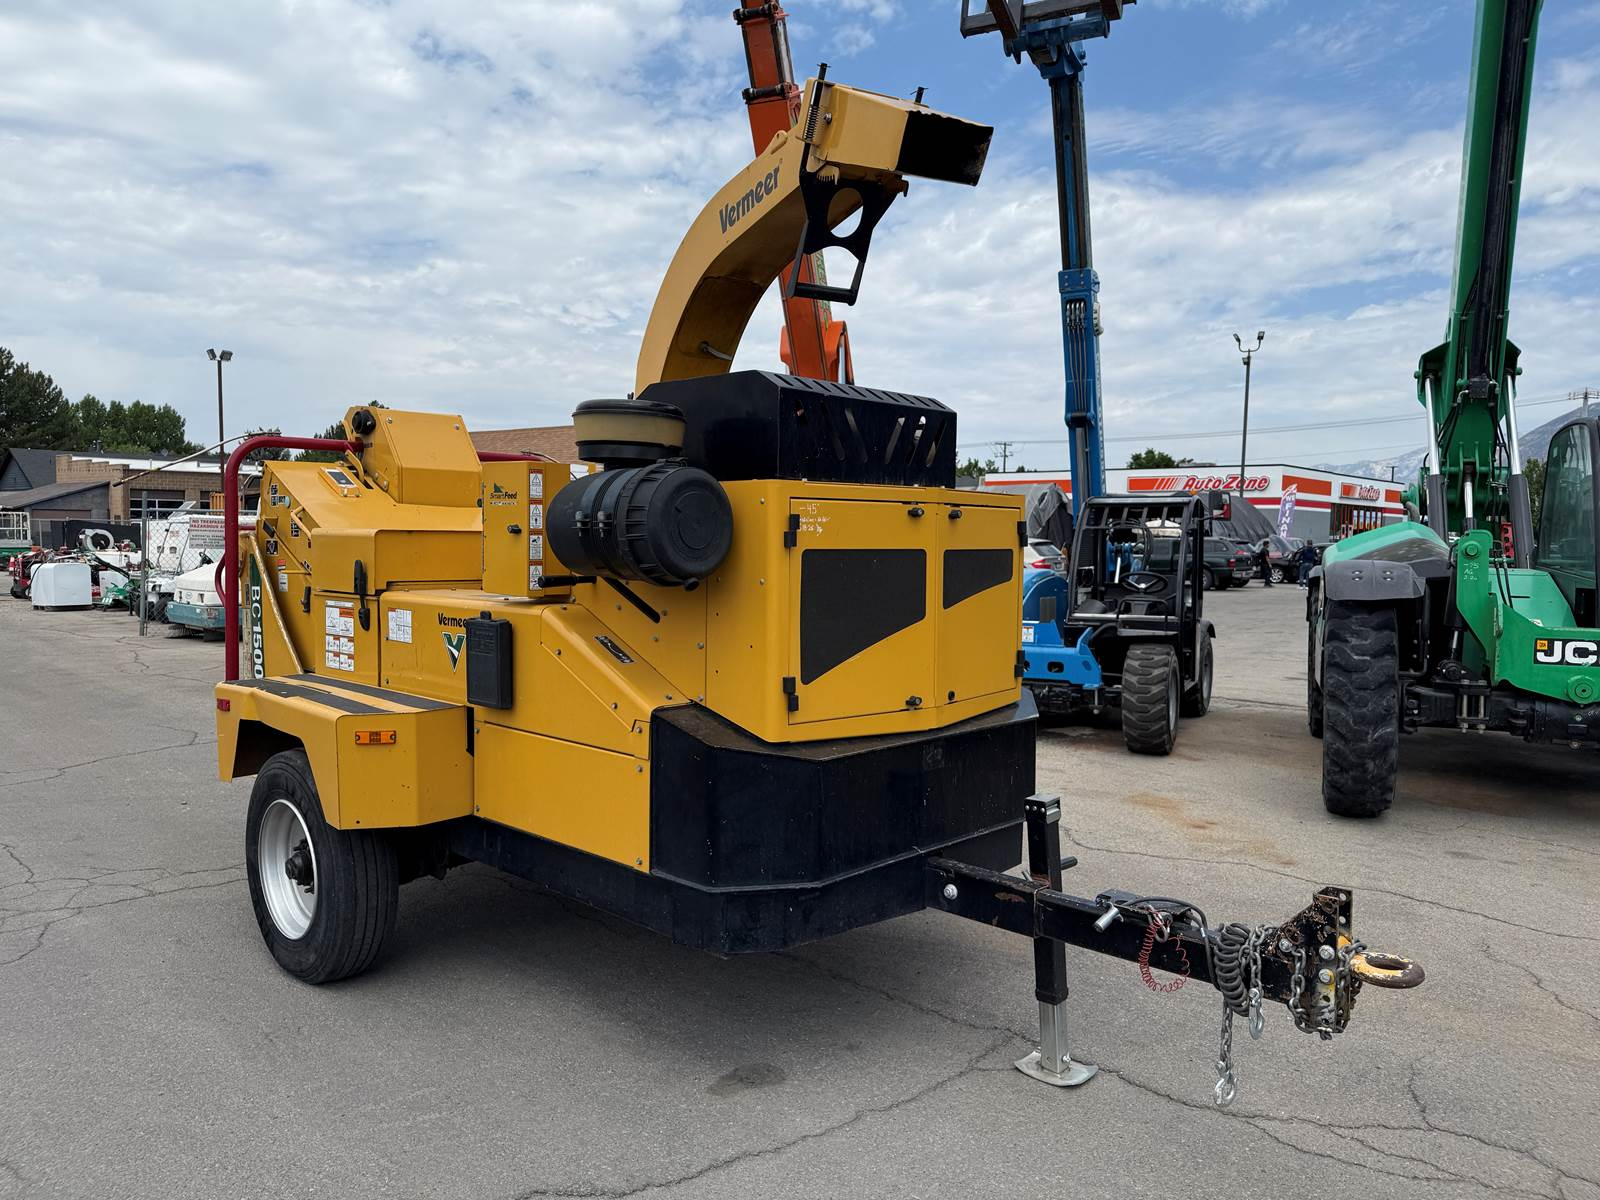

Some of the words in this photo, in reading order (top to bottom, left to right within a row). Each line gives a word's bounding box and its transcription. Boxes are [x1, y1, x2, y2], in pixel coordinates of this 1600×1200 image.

[719, 165, 780, 234] Vermeer
[1182, 474, 1270, 490] AutoZone
[1280, 503, 1293, 537] FINAN
[438, 612, 467, 627] Vermee
[1536, 640, 1600, 664] JC
